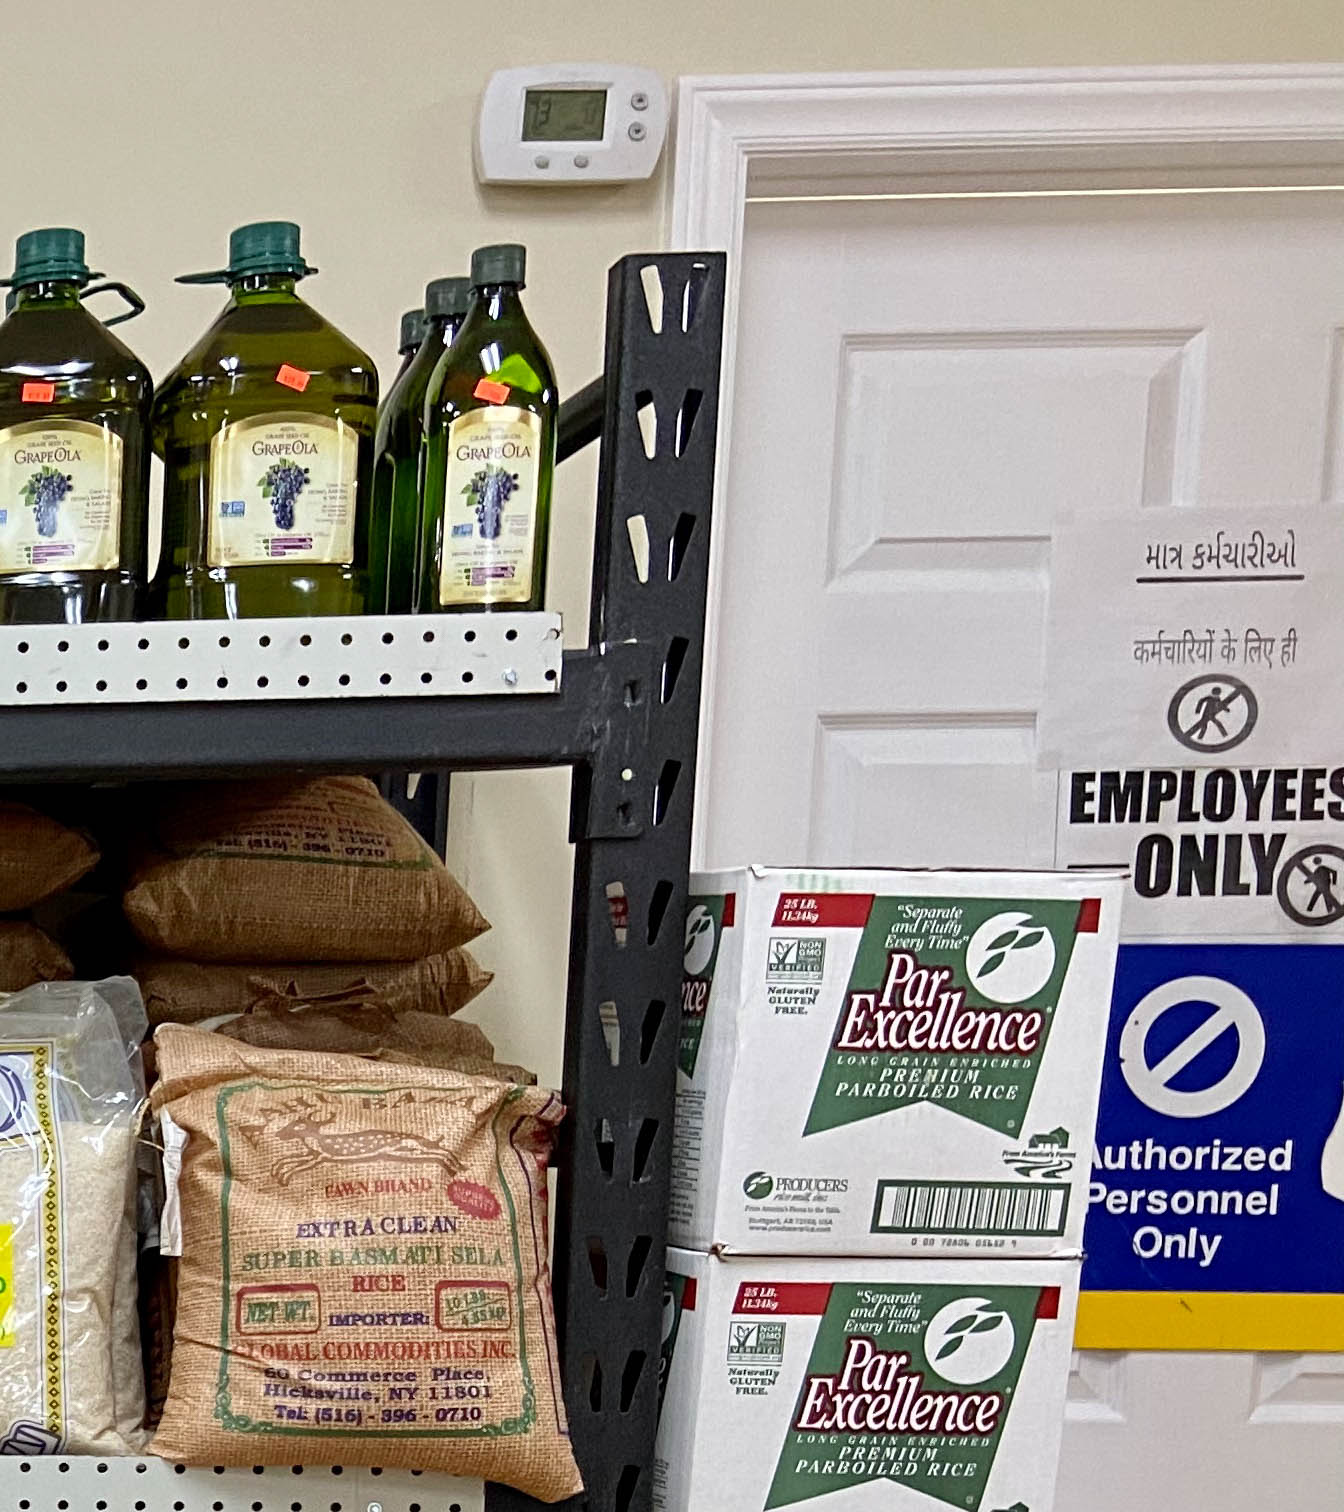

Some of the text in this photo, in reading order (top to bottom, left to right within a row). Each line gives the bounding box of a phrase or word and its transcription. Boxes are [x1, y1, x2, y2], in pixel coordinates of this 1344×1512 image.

[1221, 629, 1236, 663] के
[1244, 629, 1275, 668] लिए
[1281, 628, 1297, 667] ही
[1069, 768, 1344, 824] EMPLOYEES
[1134, 834, 1286, 898] ONLY
[891, 919, 962, 936] and Fluffy
[885, 934, 924, 951] Every
[879, 952, 951, 1008] Par
[769, 996, 816, 1006] GLUTEN
[774, 1005, 807, 1014] FREE.
[837, 992, 1043, 1052] Excellence
[837, 1056, 1032, 1069] LONG GRAIN ENRICHED
[880, 1068, 981, 1083] PREMIUM
[835, 1082, 1018, 1100] PARBOILED RICE
[776, 1178, 848, 1193] PRODUCERS
[1089, 1182, 1279, 1215] Personnel
[297, 1216, 460, 1240] EXTRA CLEAN
[1133, 1226, 1222, 1267] Only
[242, 1245, 504, 1271] SUPER BASMATI SELA
[351, 1275, 406, 1292] RICE
[328, 1312, 430, 1327] IMPORTER:
[323, 1340, 481, 1361] COMMODITIES
[838, 1338, 909, 1391] Par
[299, 1368, 417, 1382] Commerce
[388, 1386, 417, 1400] NY
[427, 1385, 491, 1400] 11801
[797, 1376, 1001, 1432] Excellence
[315, 1405, 362, 1425] (516)
[381, 1406, 416, 1423] 396
[435, 1405, 481, 1422] 0710
[795, 1460, 977, 1476] PARBOILED RICE
